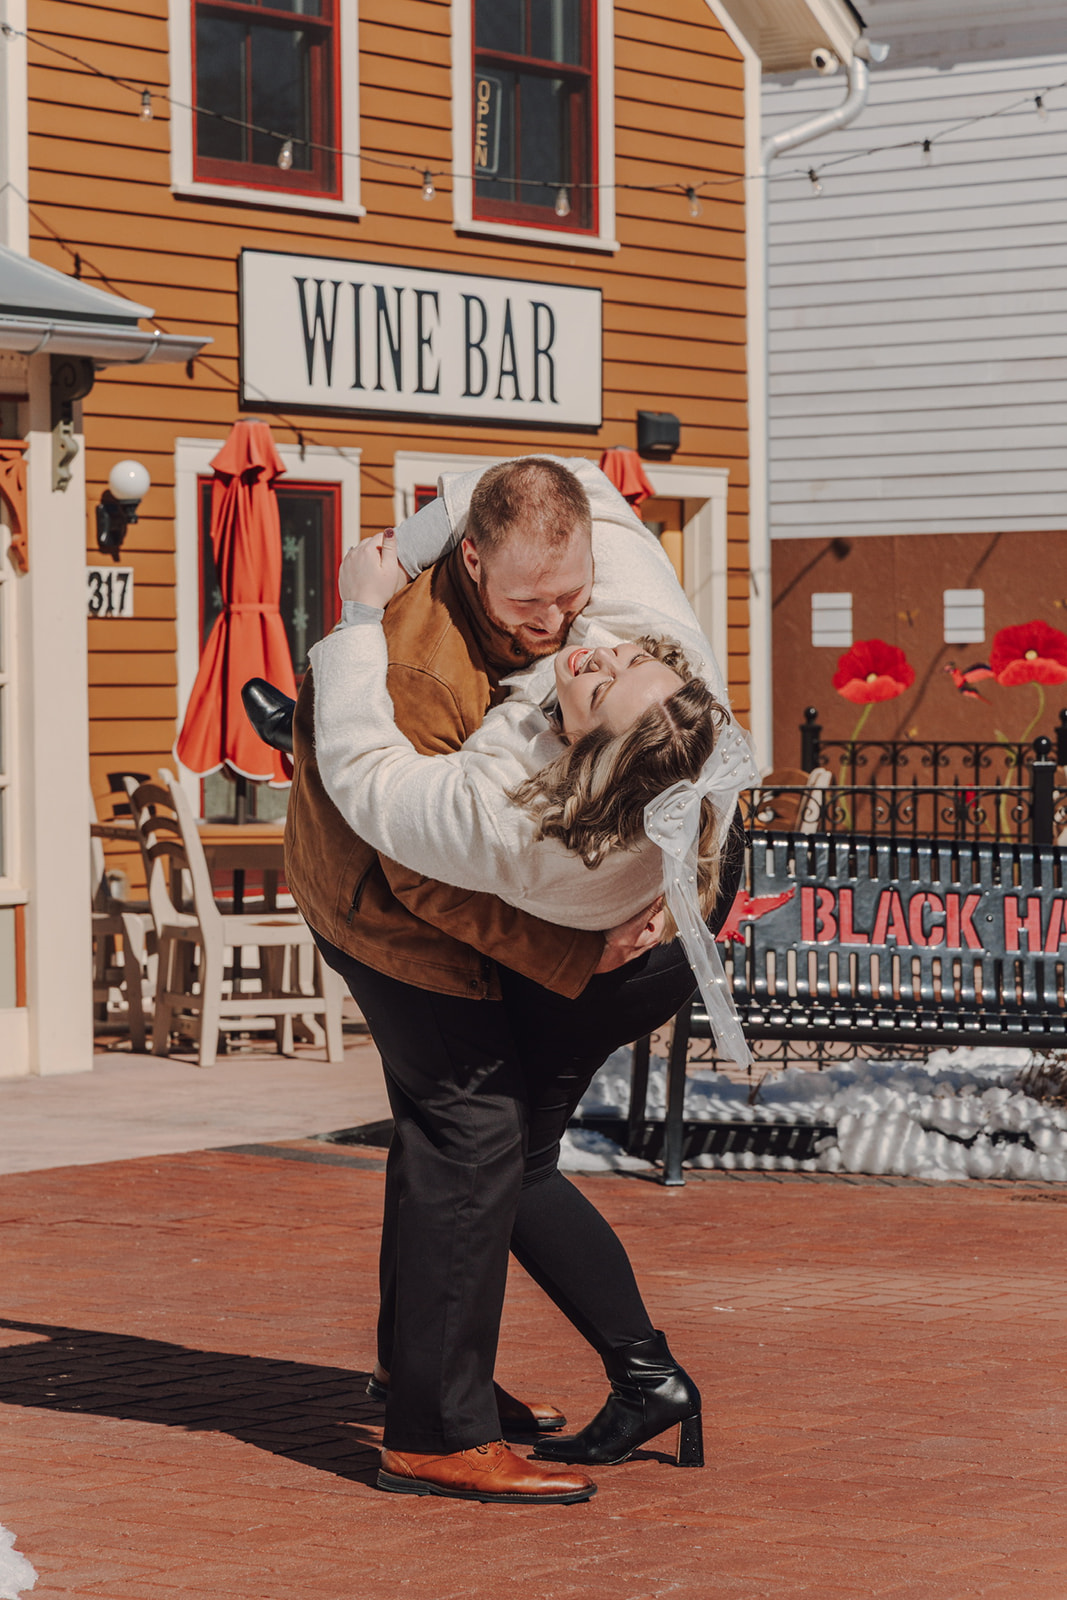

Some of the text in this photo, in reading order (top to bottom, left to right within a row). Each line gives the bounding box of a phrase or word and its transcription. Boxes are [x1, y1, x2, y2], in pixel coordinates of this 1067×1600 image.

[475, 80, 491, 167] OPEN
[293, 276, 558, 404] WINE BAR
[88, 571, 129, 615] 317
[800, 886, 984, 951] BLACK
